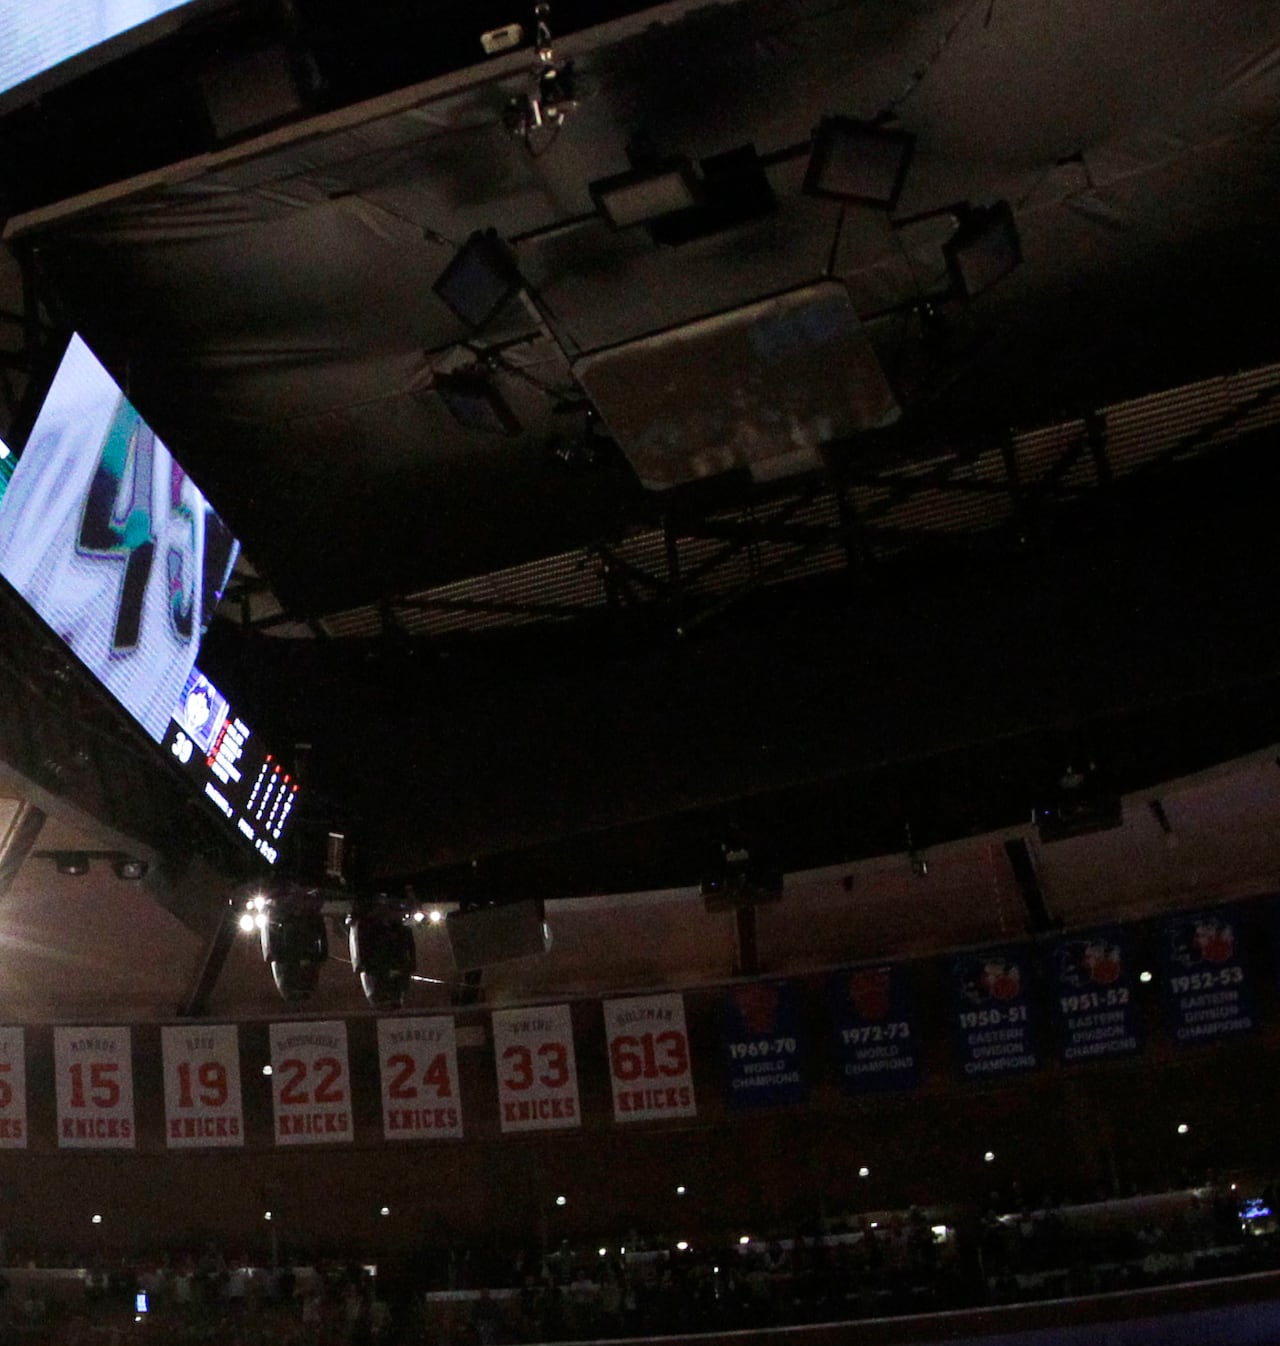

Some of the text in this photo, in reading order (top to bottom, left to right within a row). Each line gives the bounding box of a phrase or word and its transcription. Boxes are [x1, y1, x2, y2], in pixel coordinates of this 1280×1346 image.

[1170, 966, 1244, 994] 1952-53
[1060, 988, 1130, 1013] 1951-52
[960, 1005, 1028, 1028] 1950-51
[842, 1022, 911, 1044] 1972-73
[611, 1031, 688, 1081] 613
[730, 1038, 797, 1059] 1969-70
[387, 1053, 451, 1099] 24
[503, 1042, 569, 1090] 33
[69, 1063, 120, 1108] 15
[177, 1061, 228, 1107] 19
[279, 1057, 343, 1104] 22
[504, 1098, 574, 1121] KNICKS
[619, 1087, 689, 1111] KNICKS
[62, 1118, 130, 1138] KNICKS
[171, 1117, 239, 1137] KNICKS
[279, 1113, 347, 1135] KNICKS
[388, 1109, 457, 1130] KNICKS
